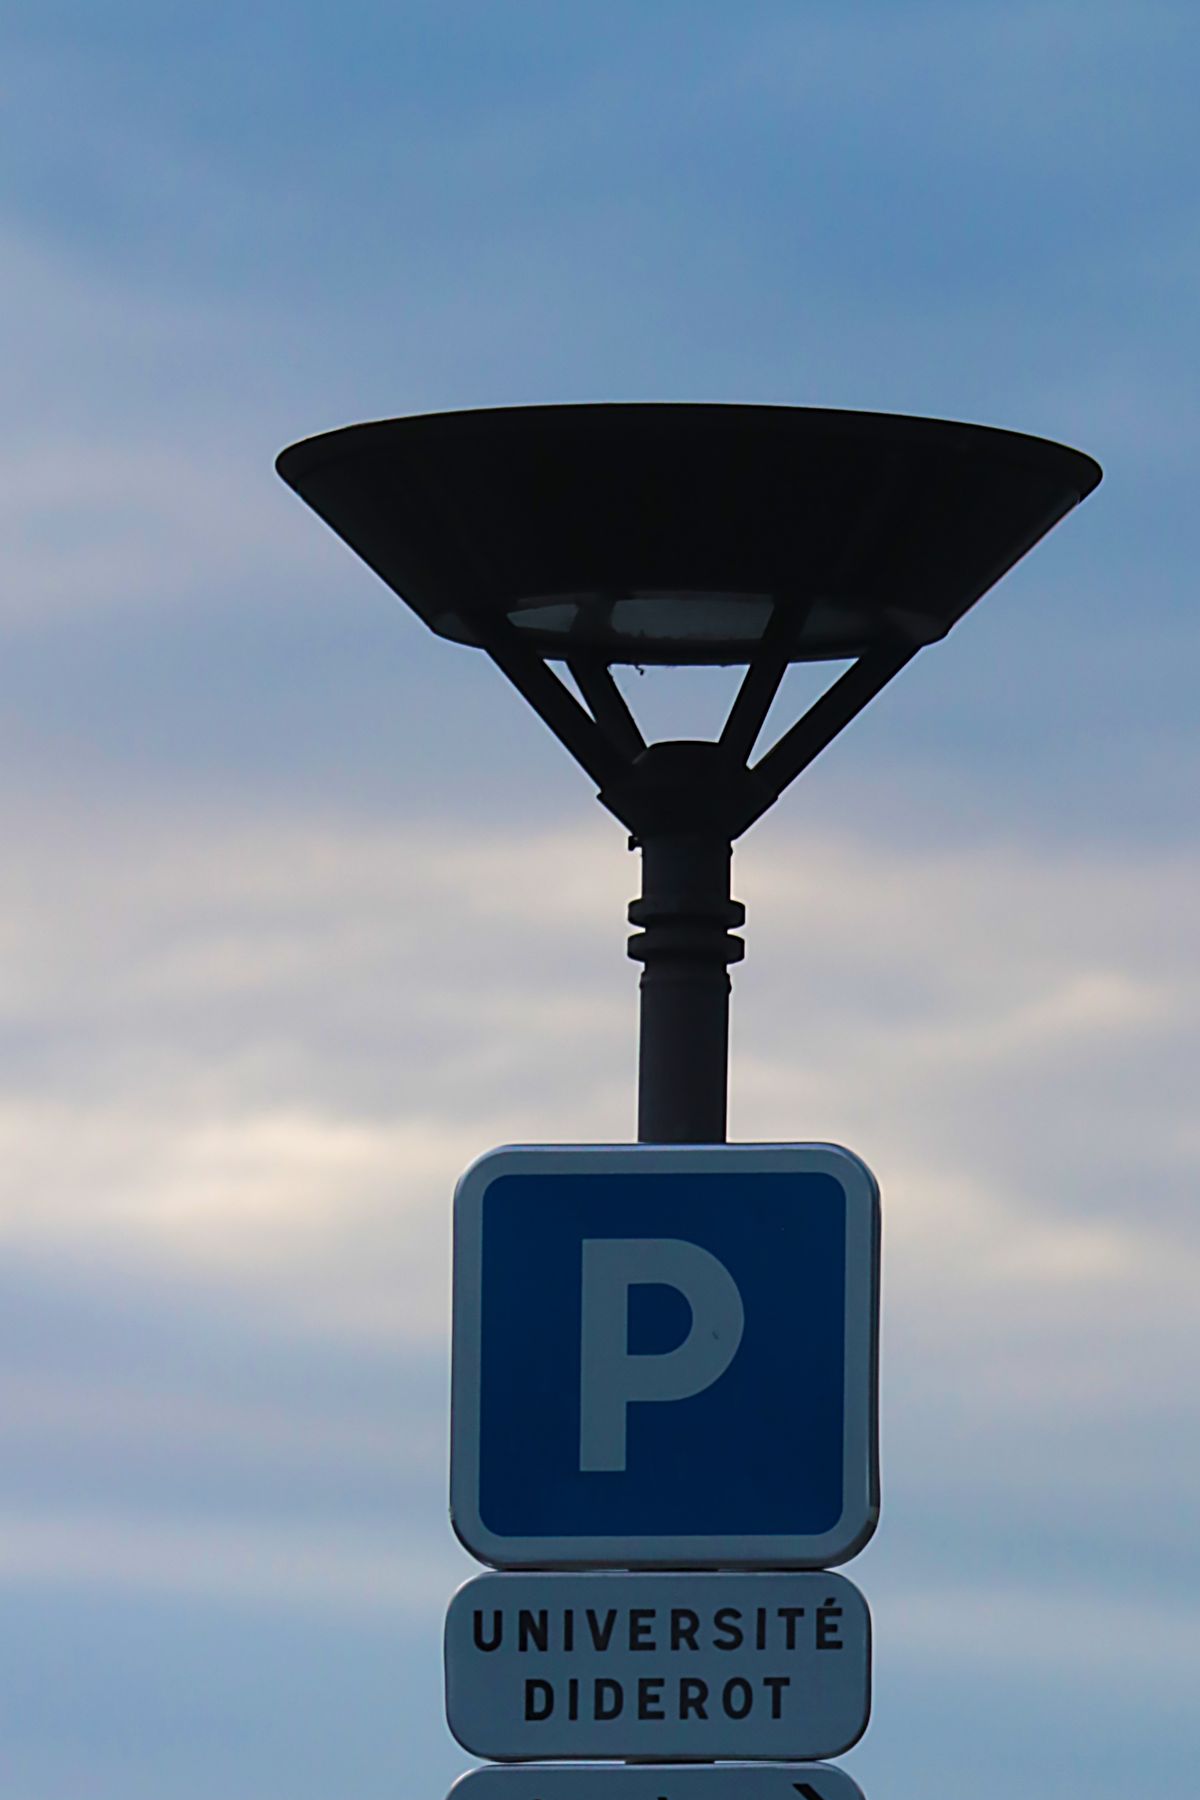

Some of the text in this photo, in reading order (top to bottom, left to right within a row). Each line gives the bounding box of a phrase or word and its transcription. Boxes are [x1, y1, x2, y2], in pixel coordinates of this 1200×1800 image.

[580, 1239, 745, 1472] P
[473, 1597, 844, 1653] UNIVERSITÉ
[524, 1676, 791, 1722] DIDEROT
